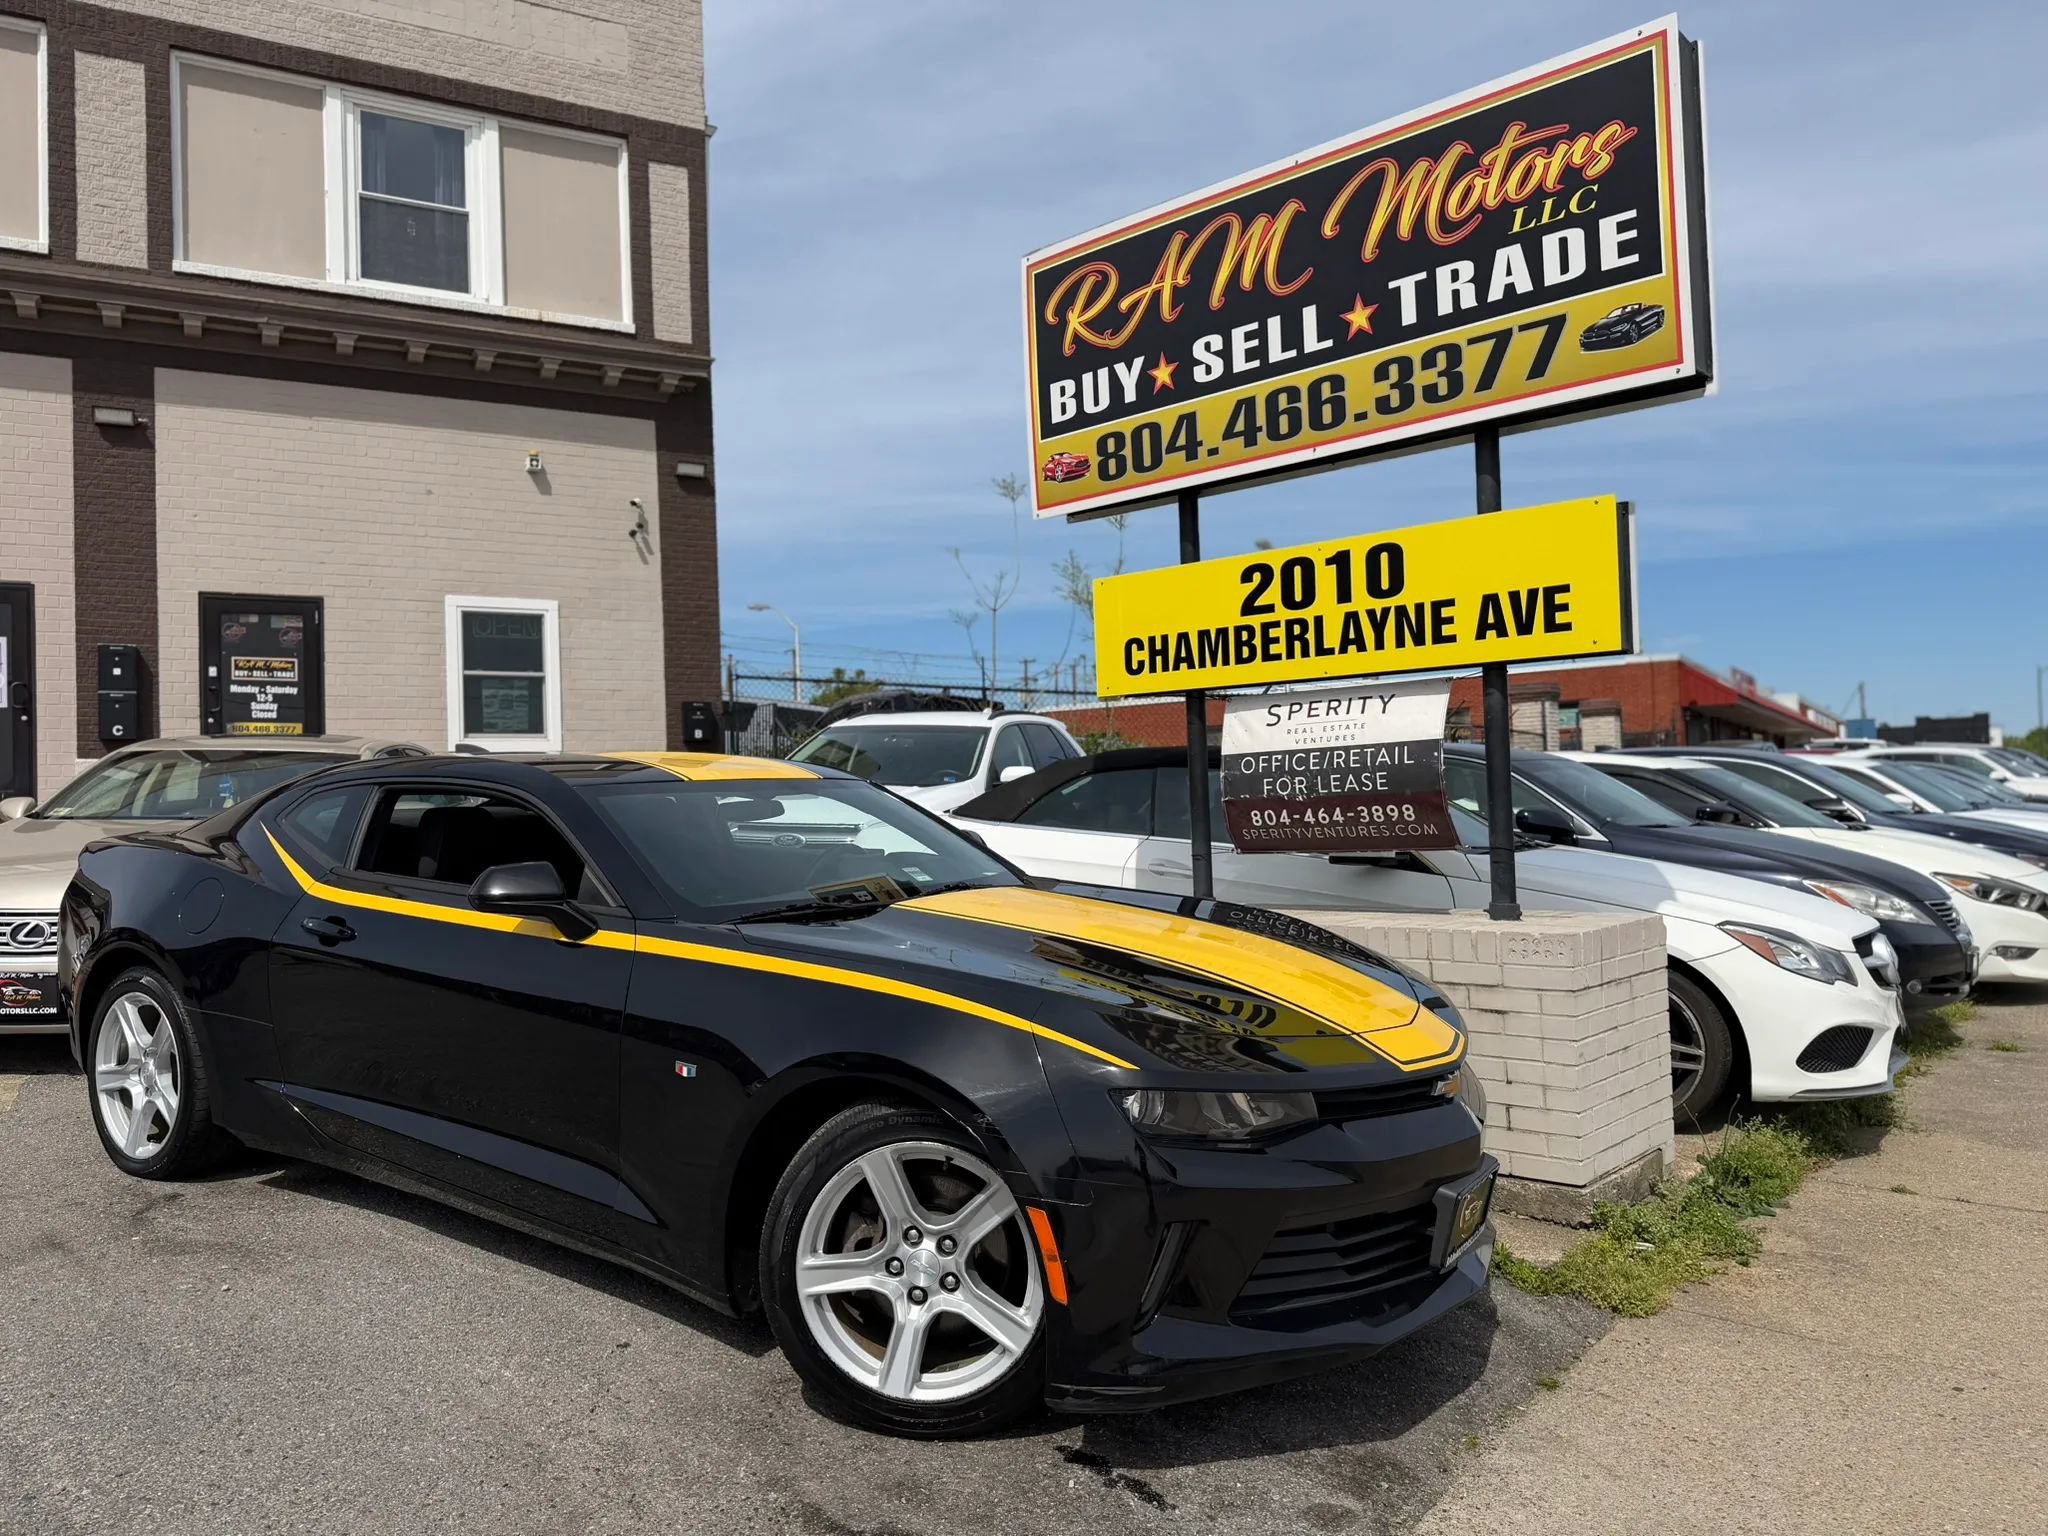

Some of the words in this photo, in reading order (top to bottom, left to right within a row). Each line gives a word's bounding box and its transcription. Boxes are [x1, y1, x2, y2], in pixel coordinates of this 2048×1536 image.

[1509, 183, 1599, 235] LLC
[1045, 198, 1313, 357] RAM
[1321, 120, 1638, 263] Motors
[1049, 357, 1146, 425] BUY
[1192, 303, 1334, 385] SELL
[1389, 209, 1640, 327] TRADE
[1096, 312, 1570, 484] 804.466.3377
[1239, 541, 1405, 617] 2010
[1124, 598, 1457, 677] CHAMBERLAYNE
[1475, 583, 1574, 642] AVE
[230, 684, 260, 694] Monday
[265, 685, 298, 695] Saturday
[251, 702, 278, 710] Sunday
[252, 711, 277, 719] Closed
[1266, 694, 1396, 727] SPERITY
[112, 724, 124, 736] C
[232, 725, 296, 734] 804.466.3377
[694, 729, 703, 739] B
[1287, 727, 1315, 735] REAL
[1322, 722, 1367, 732] ESTATE
[1294, 734, 1356, 745] VENTURES
[1240, 745, 1415, 774] OFFICE/RETAIL
[1263, 777, 1308, 796] FOR
[1317, 772, 1389, 793] LEASE
[1250, 804, 1416, 827] 804-464-3898
[1242, 823, 1439, 840] SPERITYVENTURES.COM
[0, 1007, 57, 1015] OTORSLLC.COM
